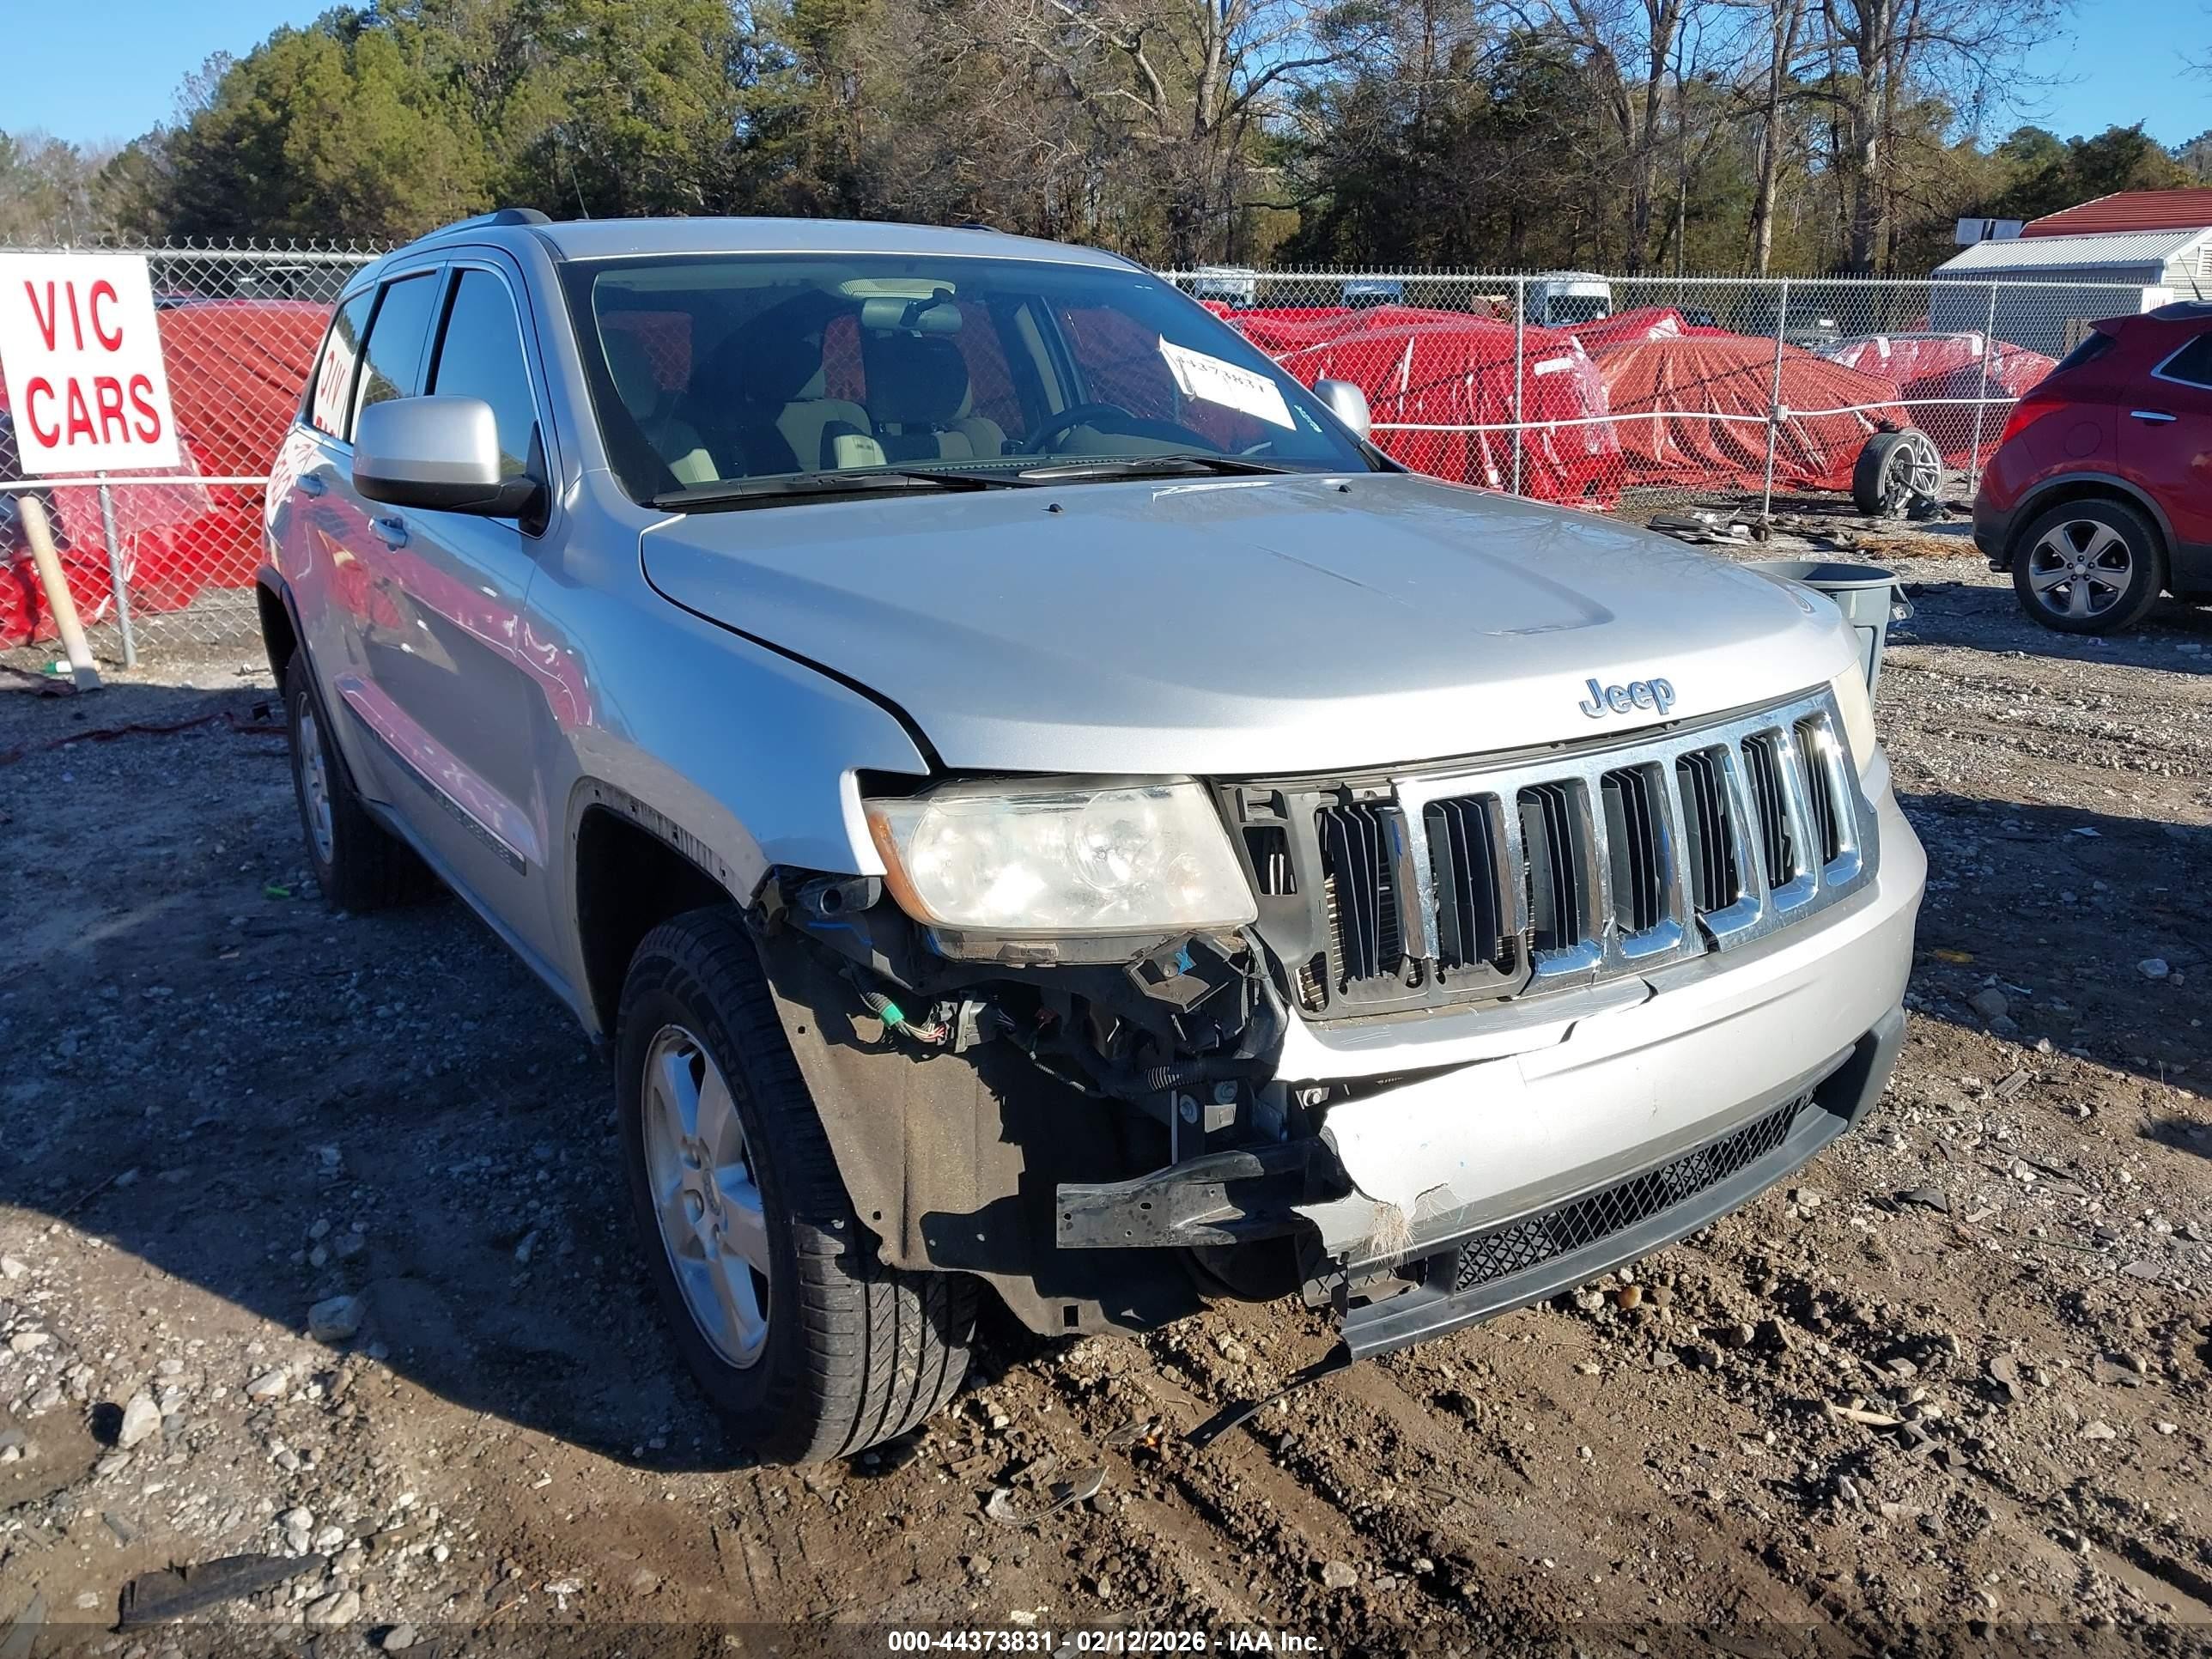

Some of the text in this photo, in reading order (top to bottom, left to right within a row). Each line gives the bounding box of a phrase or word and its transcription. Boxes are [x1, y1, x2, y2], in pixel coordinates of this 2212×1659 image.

[25, 279, 123, 352] VIC
[26, 374, 161, 449] CARS
[1579, 678, 1676, 719] Jeep
